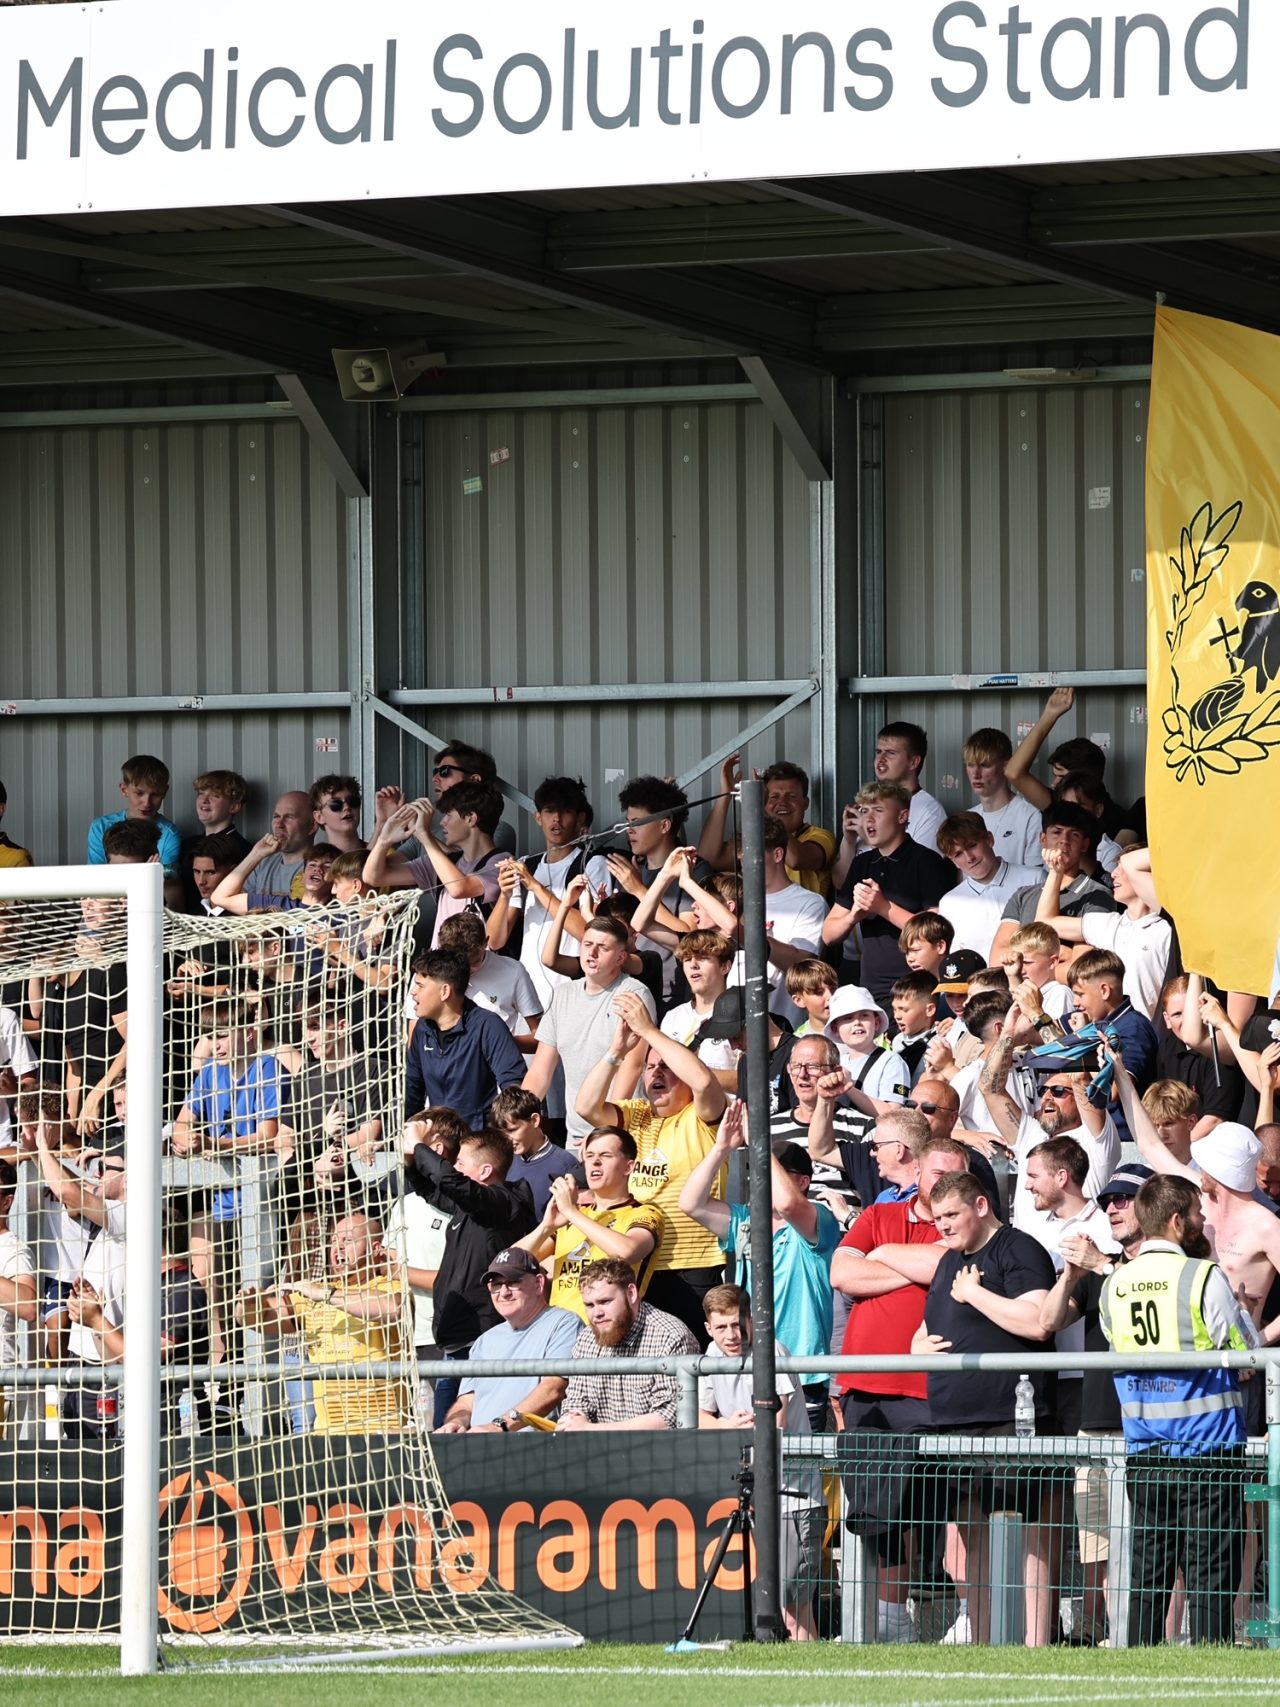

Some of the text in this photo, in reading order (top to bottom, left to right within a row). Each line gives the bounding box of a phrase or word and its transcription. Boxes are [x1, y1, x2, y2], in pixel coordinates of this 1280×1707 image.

[16, 0, 1250, 160] Medical Solutions Stand
[633, 1161, 668, 1176] ANGE
[1131, 1281, 1169, 1292] LORDS
[1130, 1300, 1160, 1346] 50
[263, 1498, 757, 1594] vanarama
